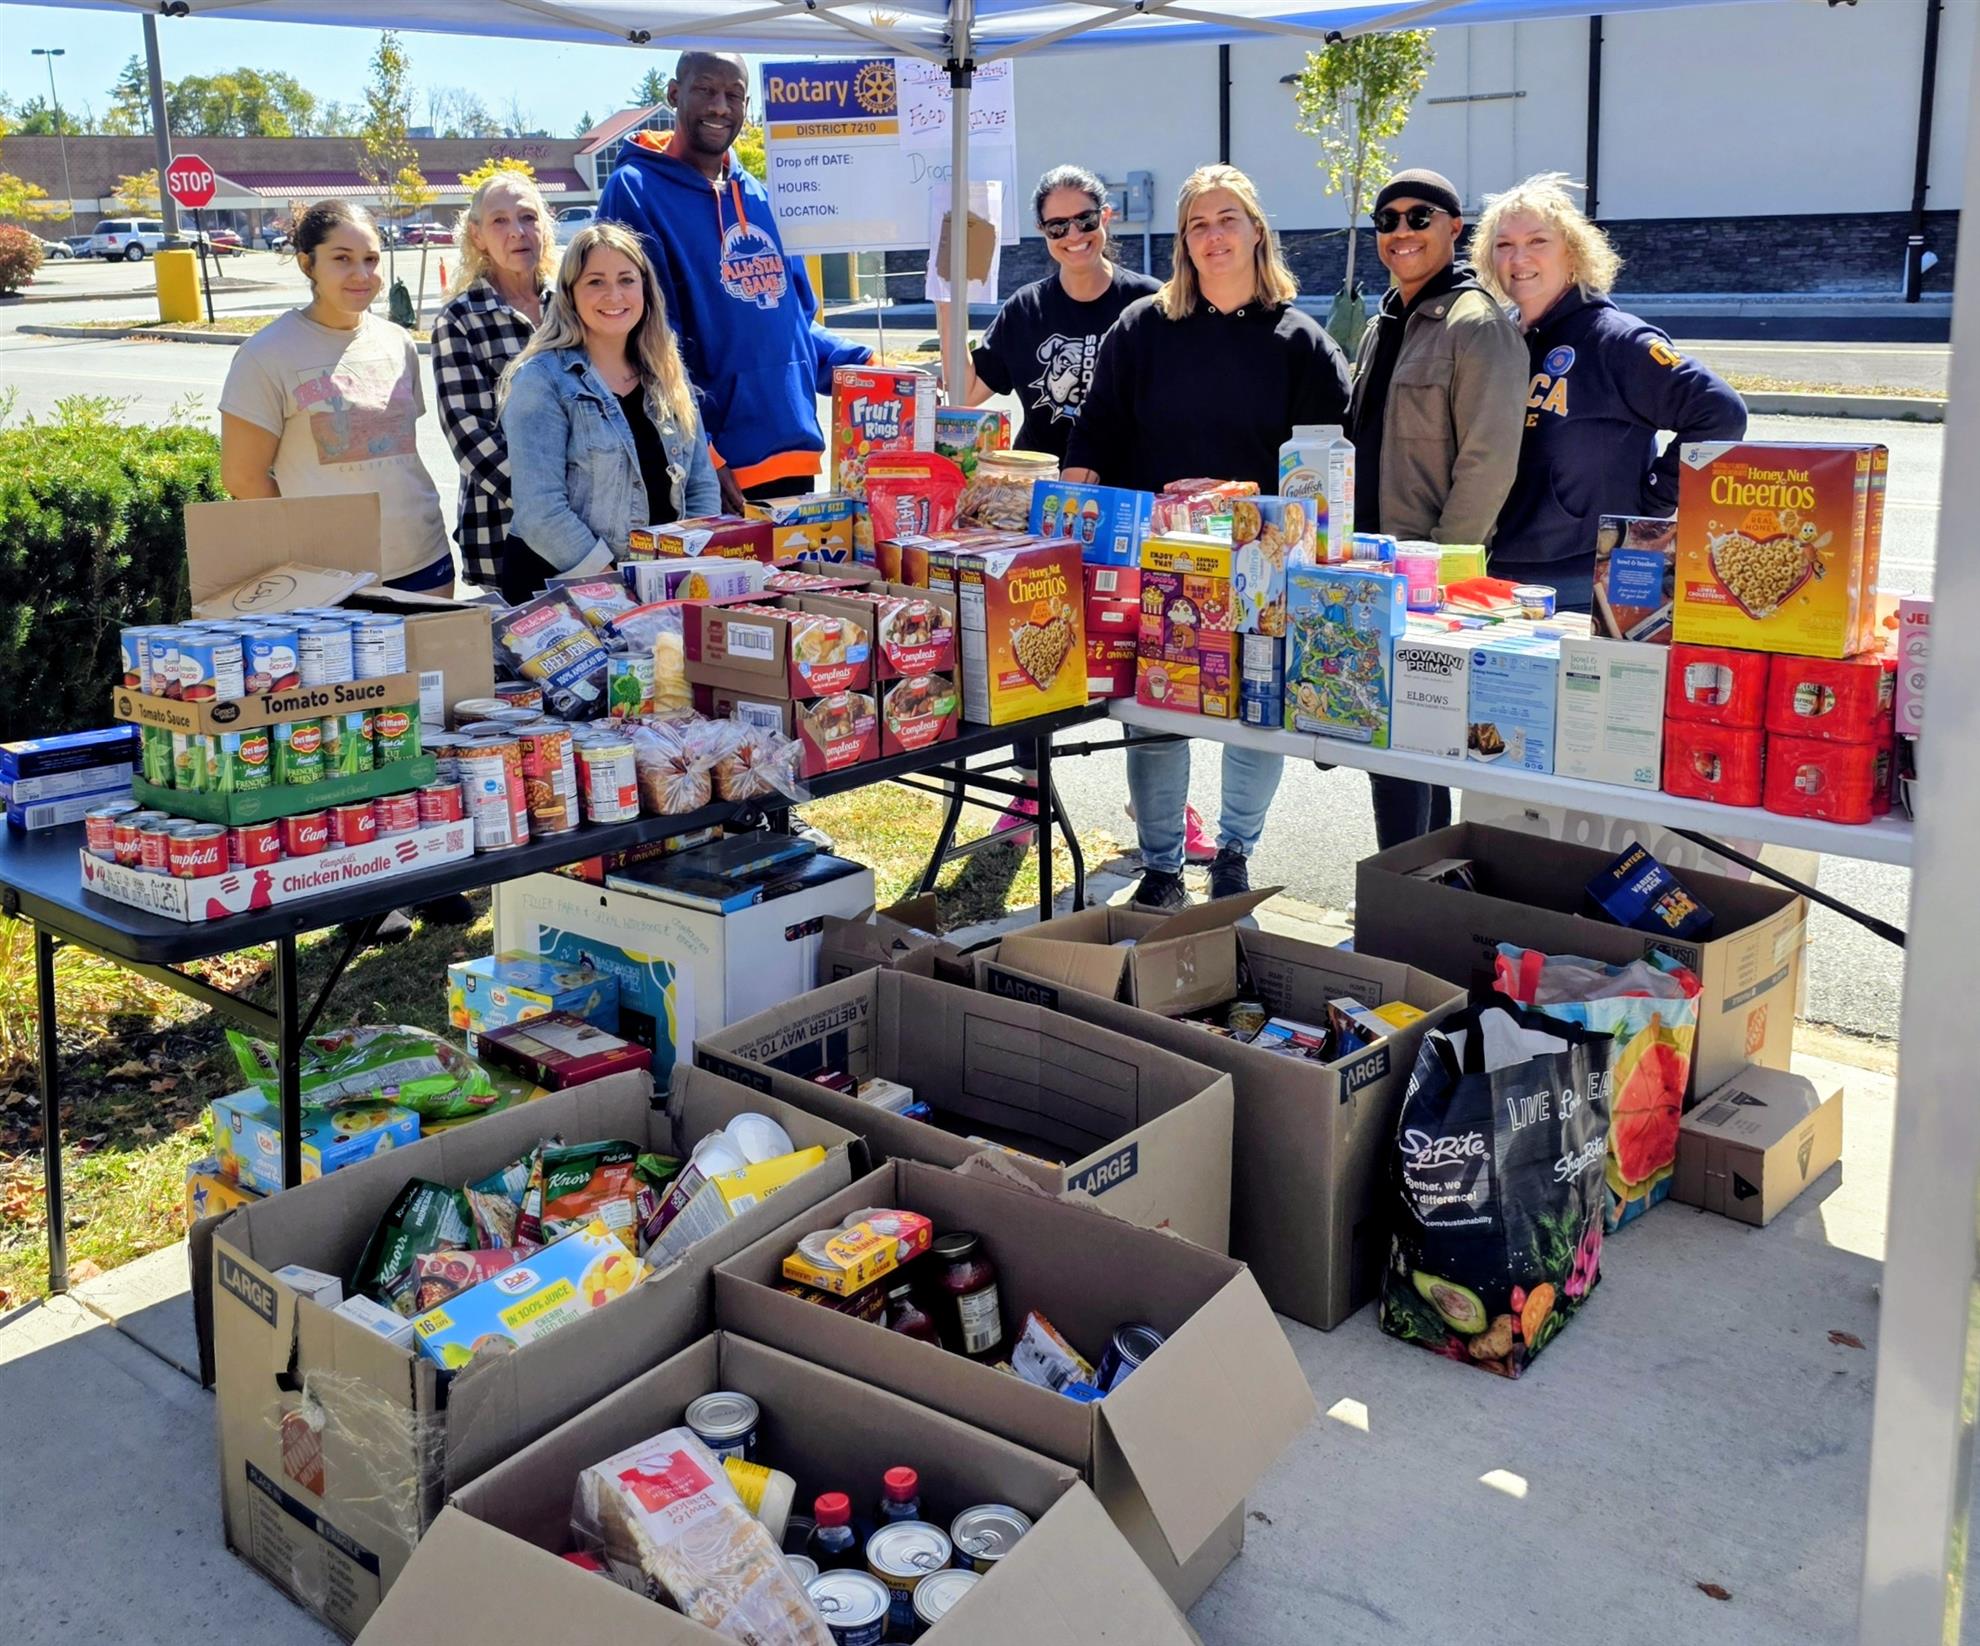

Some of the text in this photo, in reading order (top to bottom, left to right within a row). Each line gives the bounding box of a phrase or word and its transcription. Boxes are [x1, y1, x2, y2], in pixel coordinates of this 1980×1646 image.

[769, 76, 849, 108] Rotary
[797, 122, 877, 137] DISTRICT 7210
[776, 154, 855, 169] Drop off DATE:
[170, 171, 212, 193] STOP
[778, 182, 822, 197] HOURS:
[779, 205, 840, 222] LOCATION:
[851, 396, 903, 424] Fruit
[865, 422, 899, 440] Rings
[1747, 468, 1784, 485] Honey
[1787, 469, 1810, 483] Nut
[1286, 479, 1324, 498] Goldfish
[1711, 476, 1816, 510] Cheerios
[799, 501, 845, 517] FAMILY SIZE
[1745, 525, 1779, 533] HONEY
[1750, 515, 1773, 526] REAL
[723, 543, 755, 559] Honey Nut
[1029, 564, 1060, 580] Honey Nut
[1154, 560, 1173, 568] THAT
[929, 570, 952, 581] Cheerios
[960, 573, 981, 584] Cheerios
[1008, 575, 1067, 604] Cheerios
[901, 648, 937, 664] Compleats
[1396, 648, 1464, 671] GIOVANNI
[269, 660, 293, 671] Sauce
[1407, 661, 1452, 677] PRIMO
[811, 668, 851, 684] Compleats
[261, 683, 386, 715] Tomato Sauce
[1407, 690, 1449, 706] ELBOWS
[139, 703, 190, 728] Tomato Sauce
[901, 719, 938, 736] Compleats
[826, 738, 860, 757] ompleats
[319, 852, 358, 870] Campbell's
[1614, 849, 1646, 879] PLANTERS
[282, 857, 391, 894] Chicken Noodle
[1631, 867, 1661, 894] VARIETY
[1642, 877, 1663, 895] PACK
[992, 974, 1052, 1007] LARGE
[809, 1006, 858, 1037] BETTER
[780, 1026, 806, 1049] WAY
[760, 1040, 778, 1058] TO
[1507, 1091, 1551, 1132] LIVE
[1554, 1136, 1608, 1183] ShopRite
[548, 1171, 592, 1189] Knorr
[1445, 1179, 1461, 1191] we
[1420, 1191, 1477, 1205] difference!
[379, 1234, 408, 1286] Knorr
[503, 1270, 529, 1288] Dole
[223, 1259, 272, 1318] LARGE
[506, 1285, 569, 1325] IN 100% JUICE
[418, 1318, 434, 1333] 16
[535, 1307, 565, 1328] CHERRY
[558, 1309, 582, 1327] FRUIT
